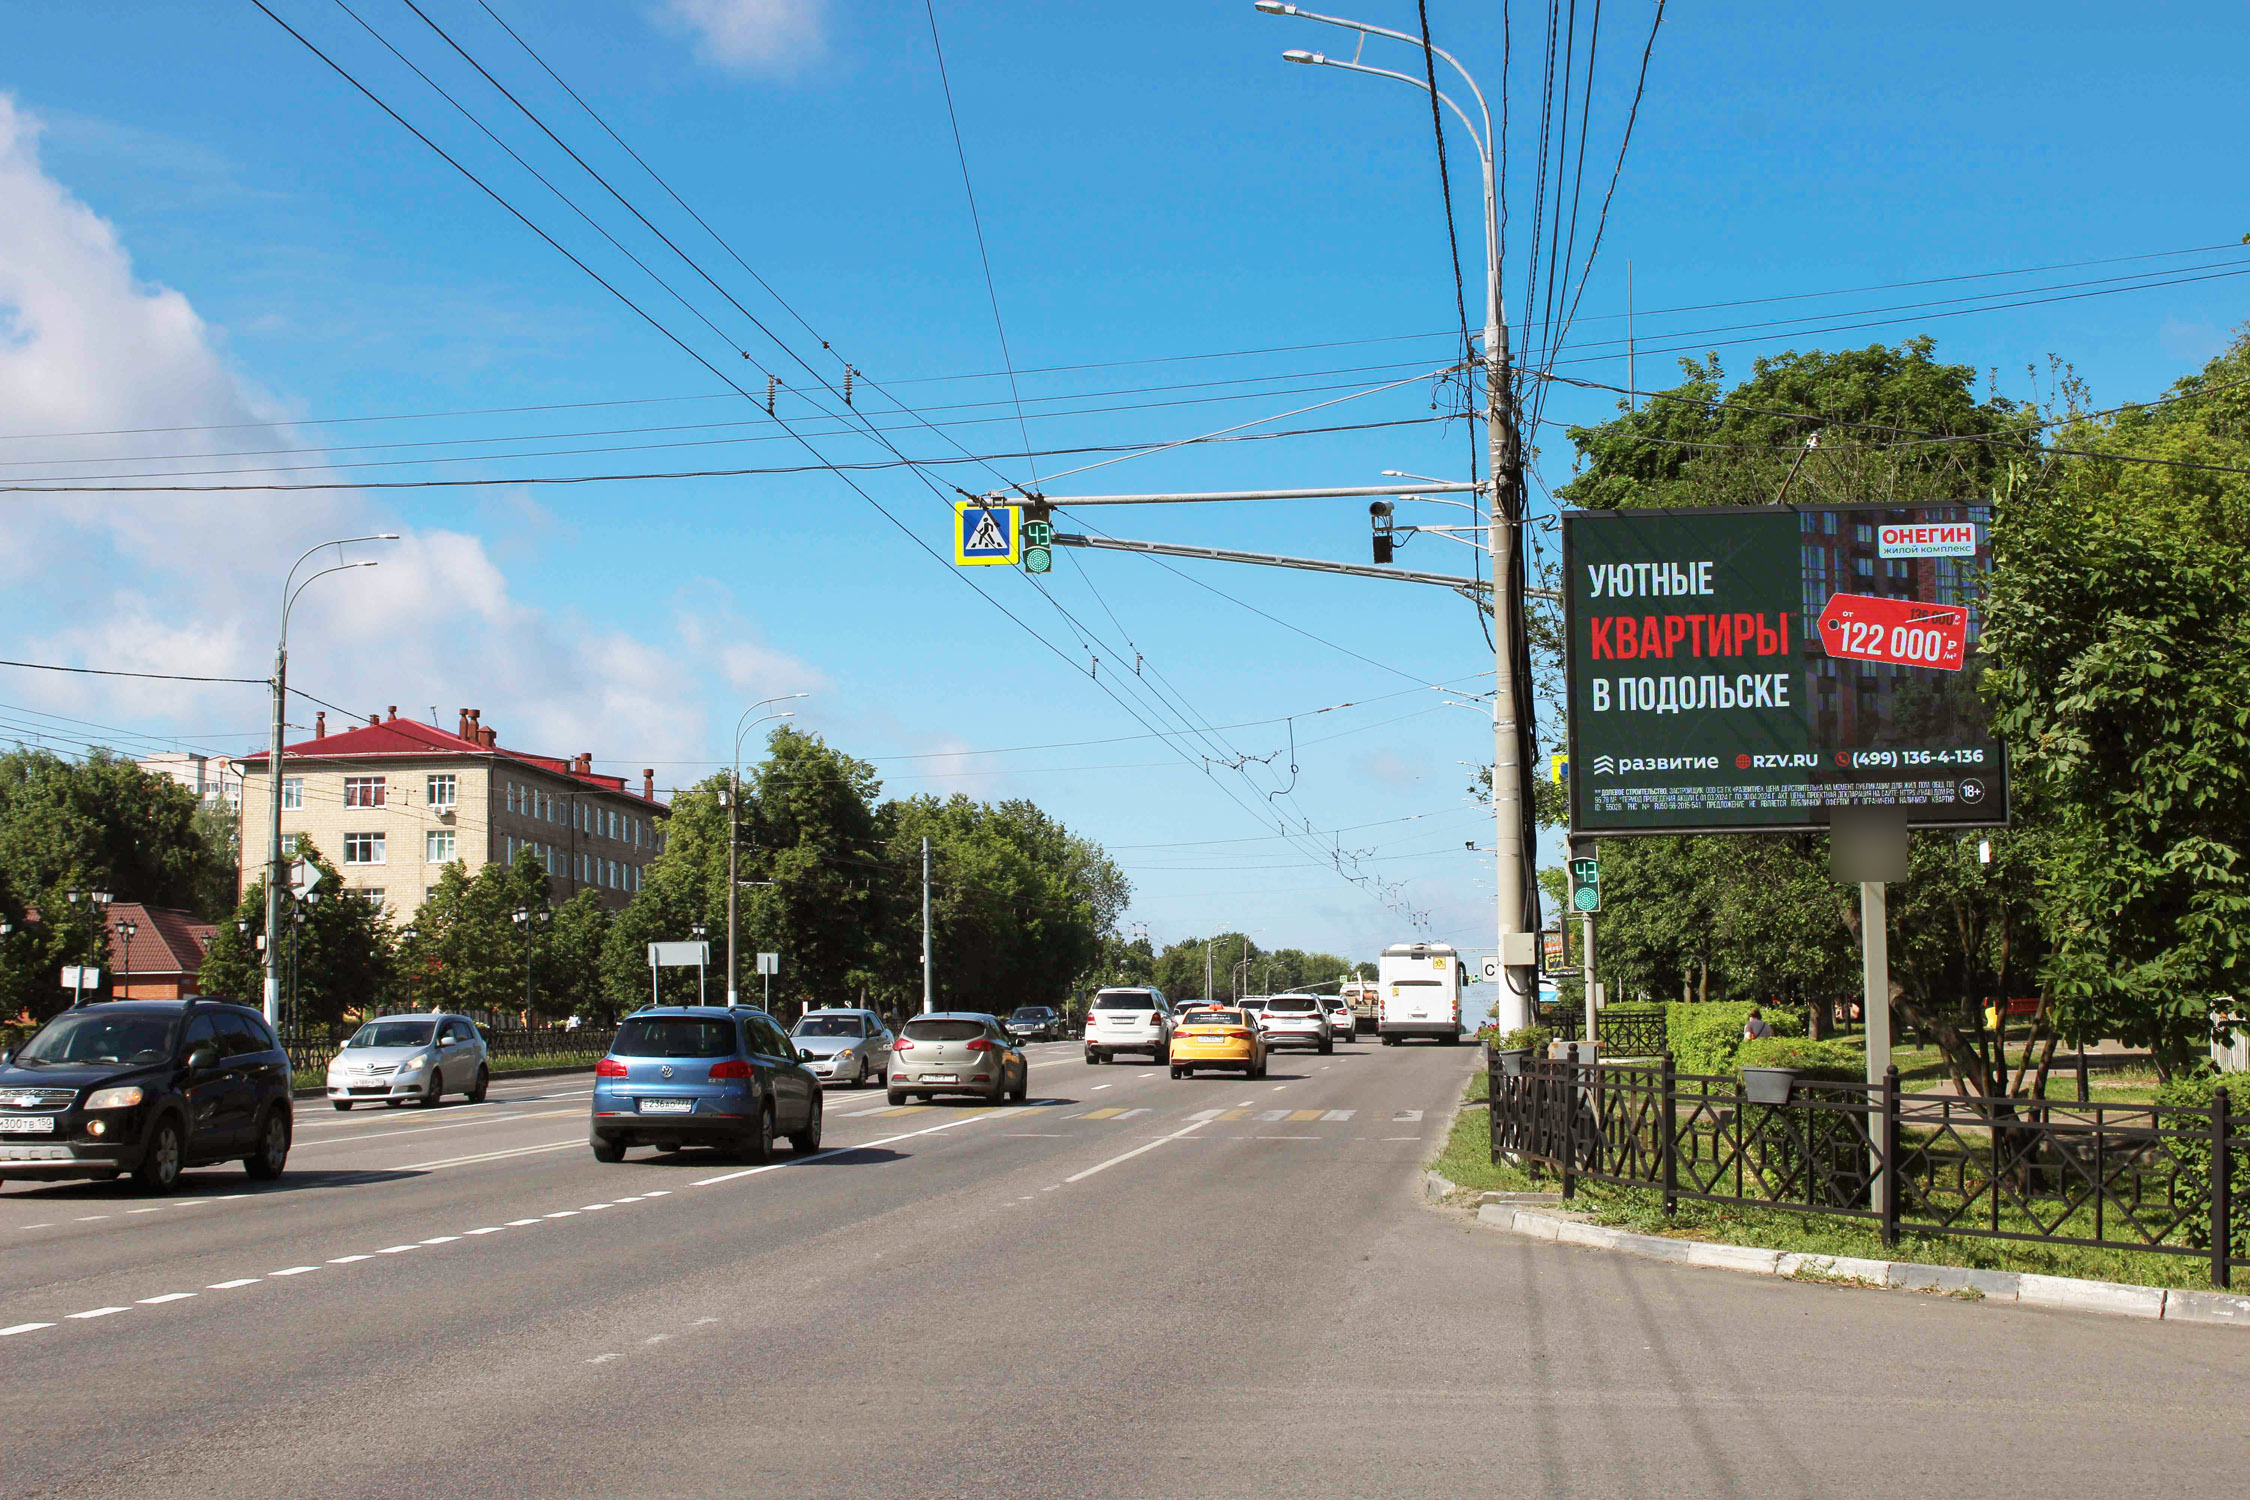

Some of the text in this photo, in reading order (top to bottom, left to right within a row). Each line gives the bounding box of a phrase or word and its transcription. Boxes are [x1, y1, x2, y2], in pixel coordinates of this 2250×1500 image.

[1028, 523, 1050, 546] 43
[1882, 527, 1971, 545] ОНЕГИН
[1883, 544, 1971, 554] жилой комплекс
[1587, 561, 1714, 598] УЮТНЫЕ
[1840, 621, 1885, 656] 122
[1592, 673, 1790, 715] В ПОДОЛЬСКЕ
[1618, 755, 1720, 775] развитие
[1752, 753, 1819, 769] RZV.RU
[1852, 749, 1984, 769] (499) 136-4-136
[1962, 784, 1981, 798] 18+
[1575, 861, 1598, 884] 43
